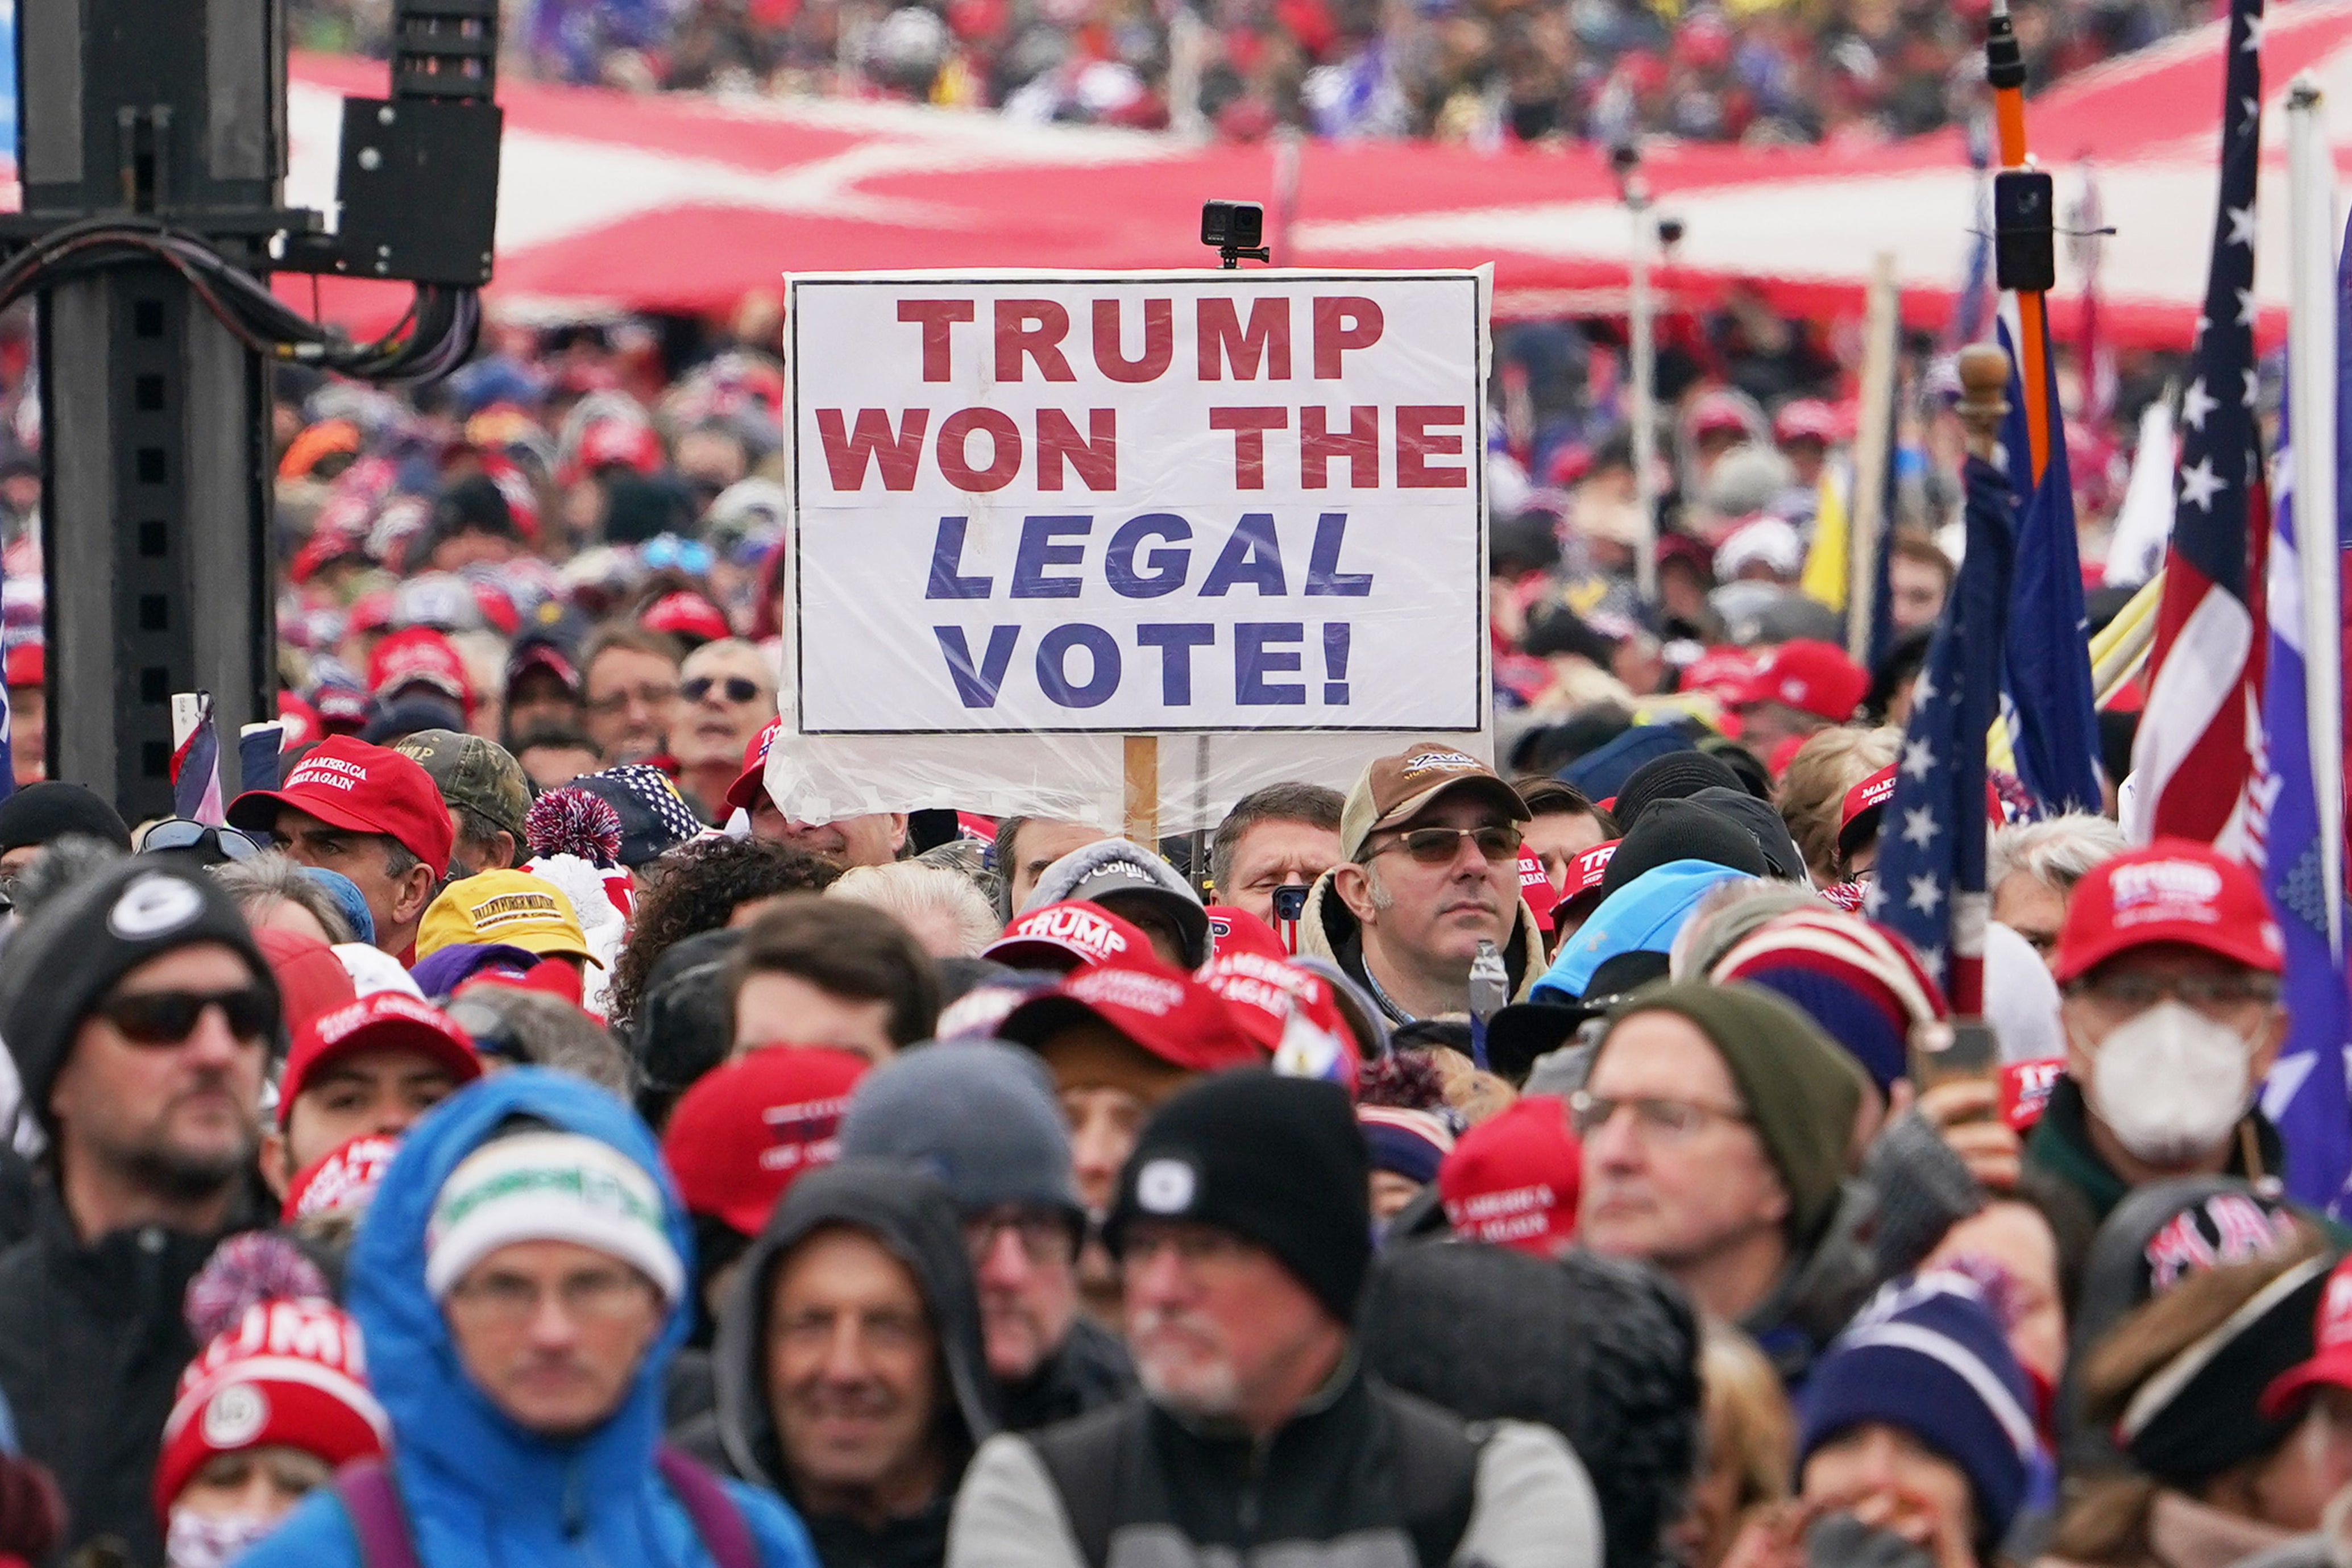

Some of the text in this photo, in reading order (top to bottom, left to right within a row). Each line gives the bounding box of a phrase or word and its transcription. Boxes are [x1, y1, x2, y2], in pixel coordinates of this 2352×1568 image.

[897, 296, 1384, 383] TRUMP
[815, 405, 1468, 493] WON THE
[926, 513, 1373, 599] LEGAL
[934, 622, 1351, 708] VOTE!
[309, 757, 367, 780] AMERICA
[309, 771, 355, 791] AGAIN
[1519, 872, 1547, 886] REAT
[1017, 909, 1126, 960] TRUMP
